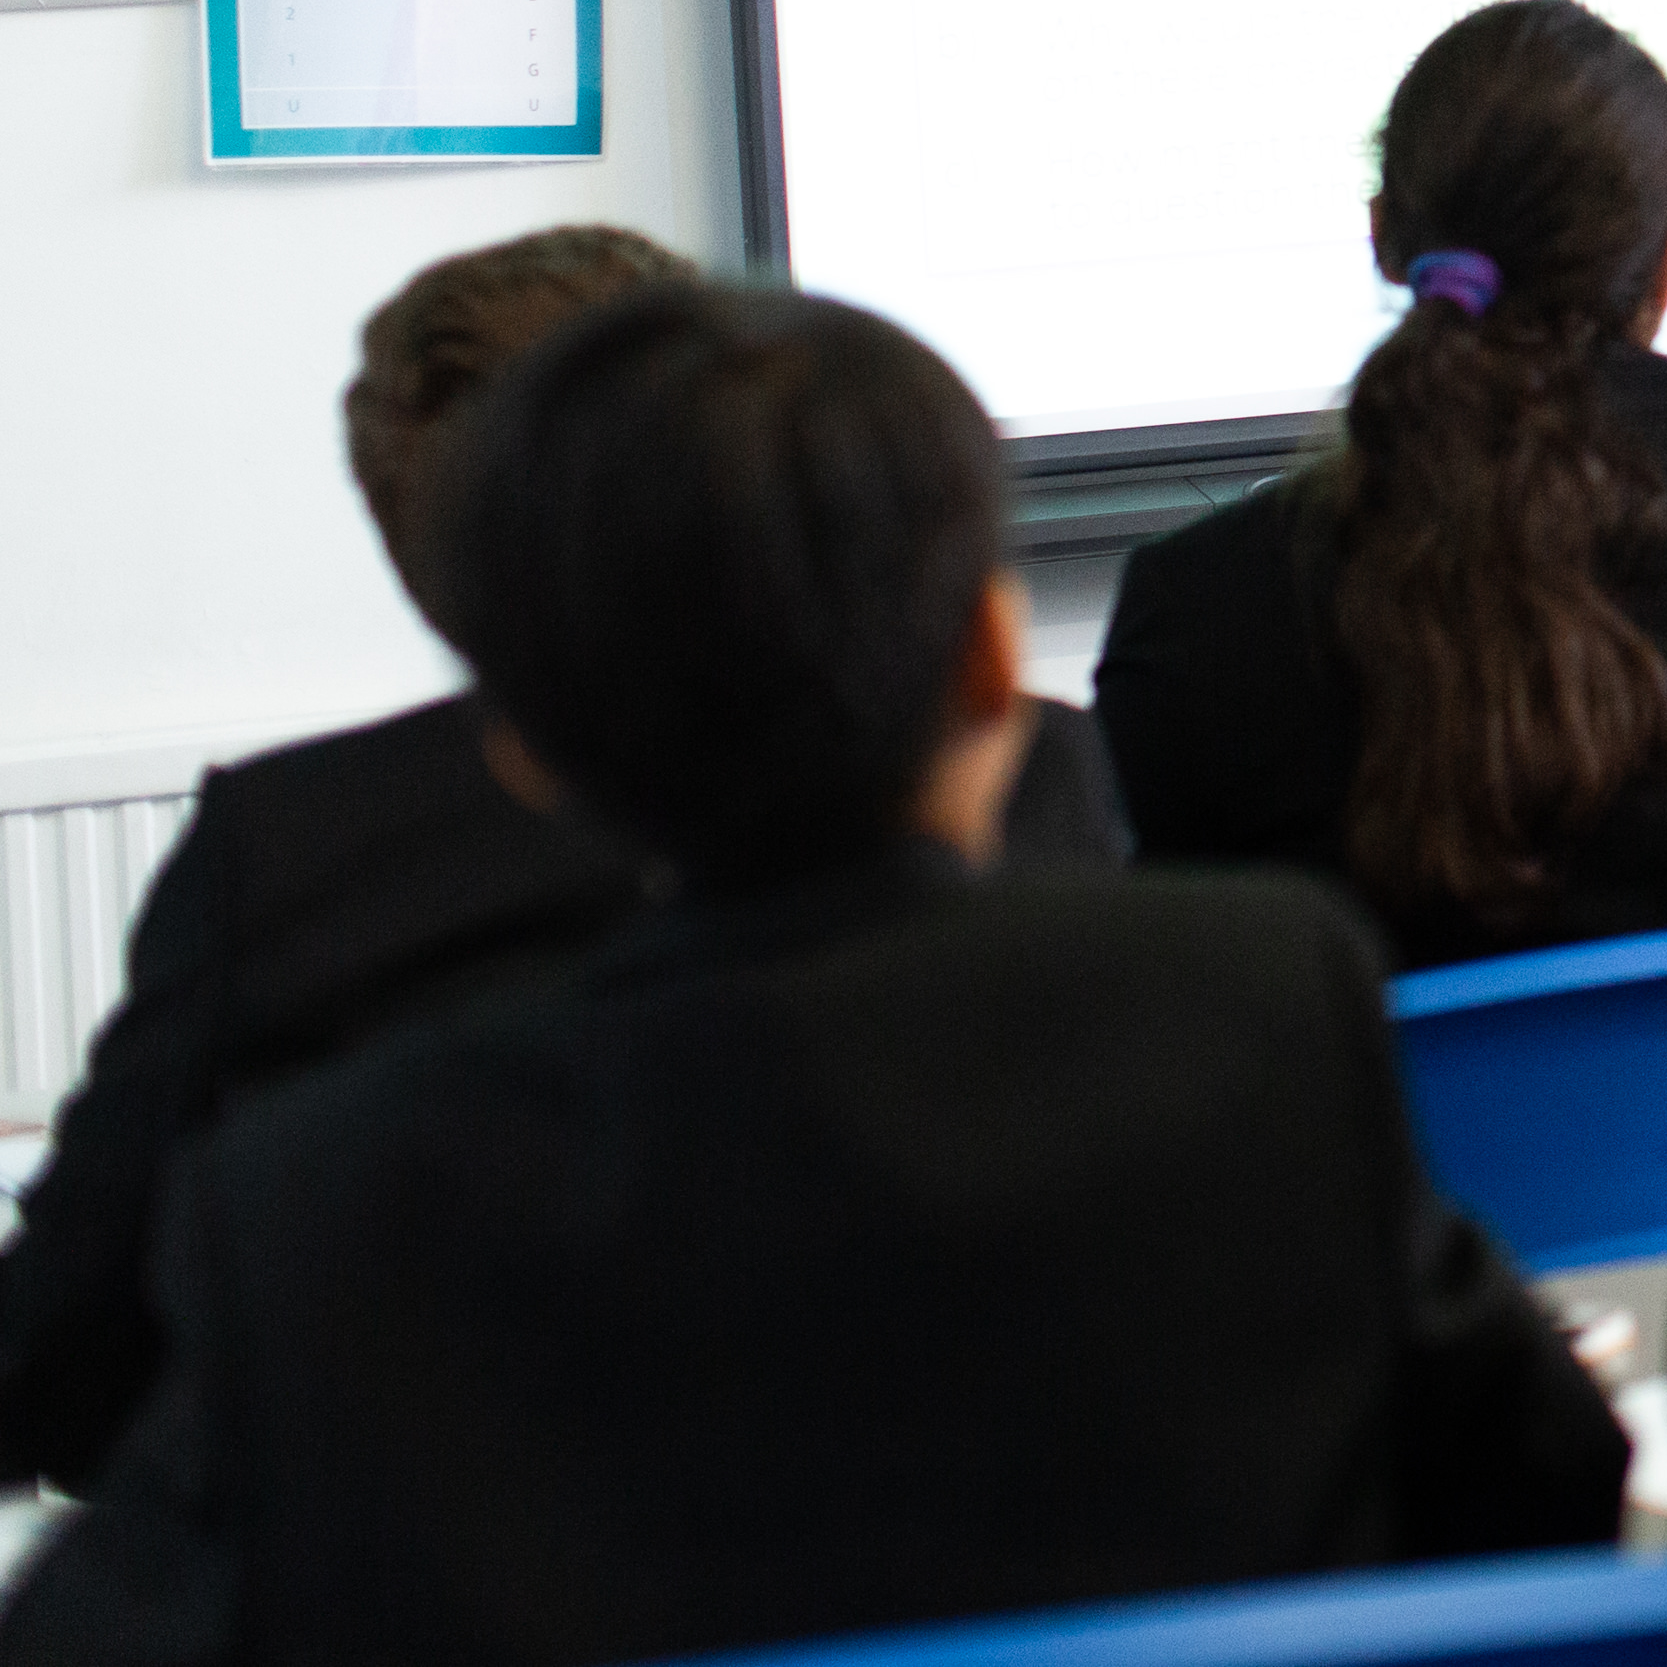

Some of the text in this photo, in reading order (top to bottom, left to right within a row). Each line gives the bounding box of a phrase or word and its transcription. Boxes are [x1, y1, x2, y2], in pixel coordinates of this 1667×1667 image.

[529, 29, 537, 42] F
[528, 63, 540, 78] G
[529, 98, 539, 112] U
